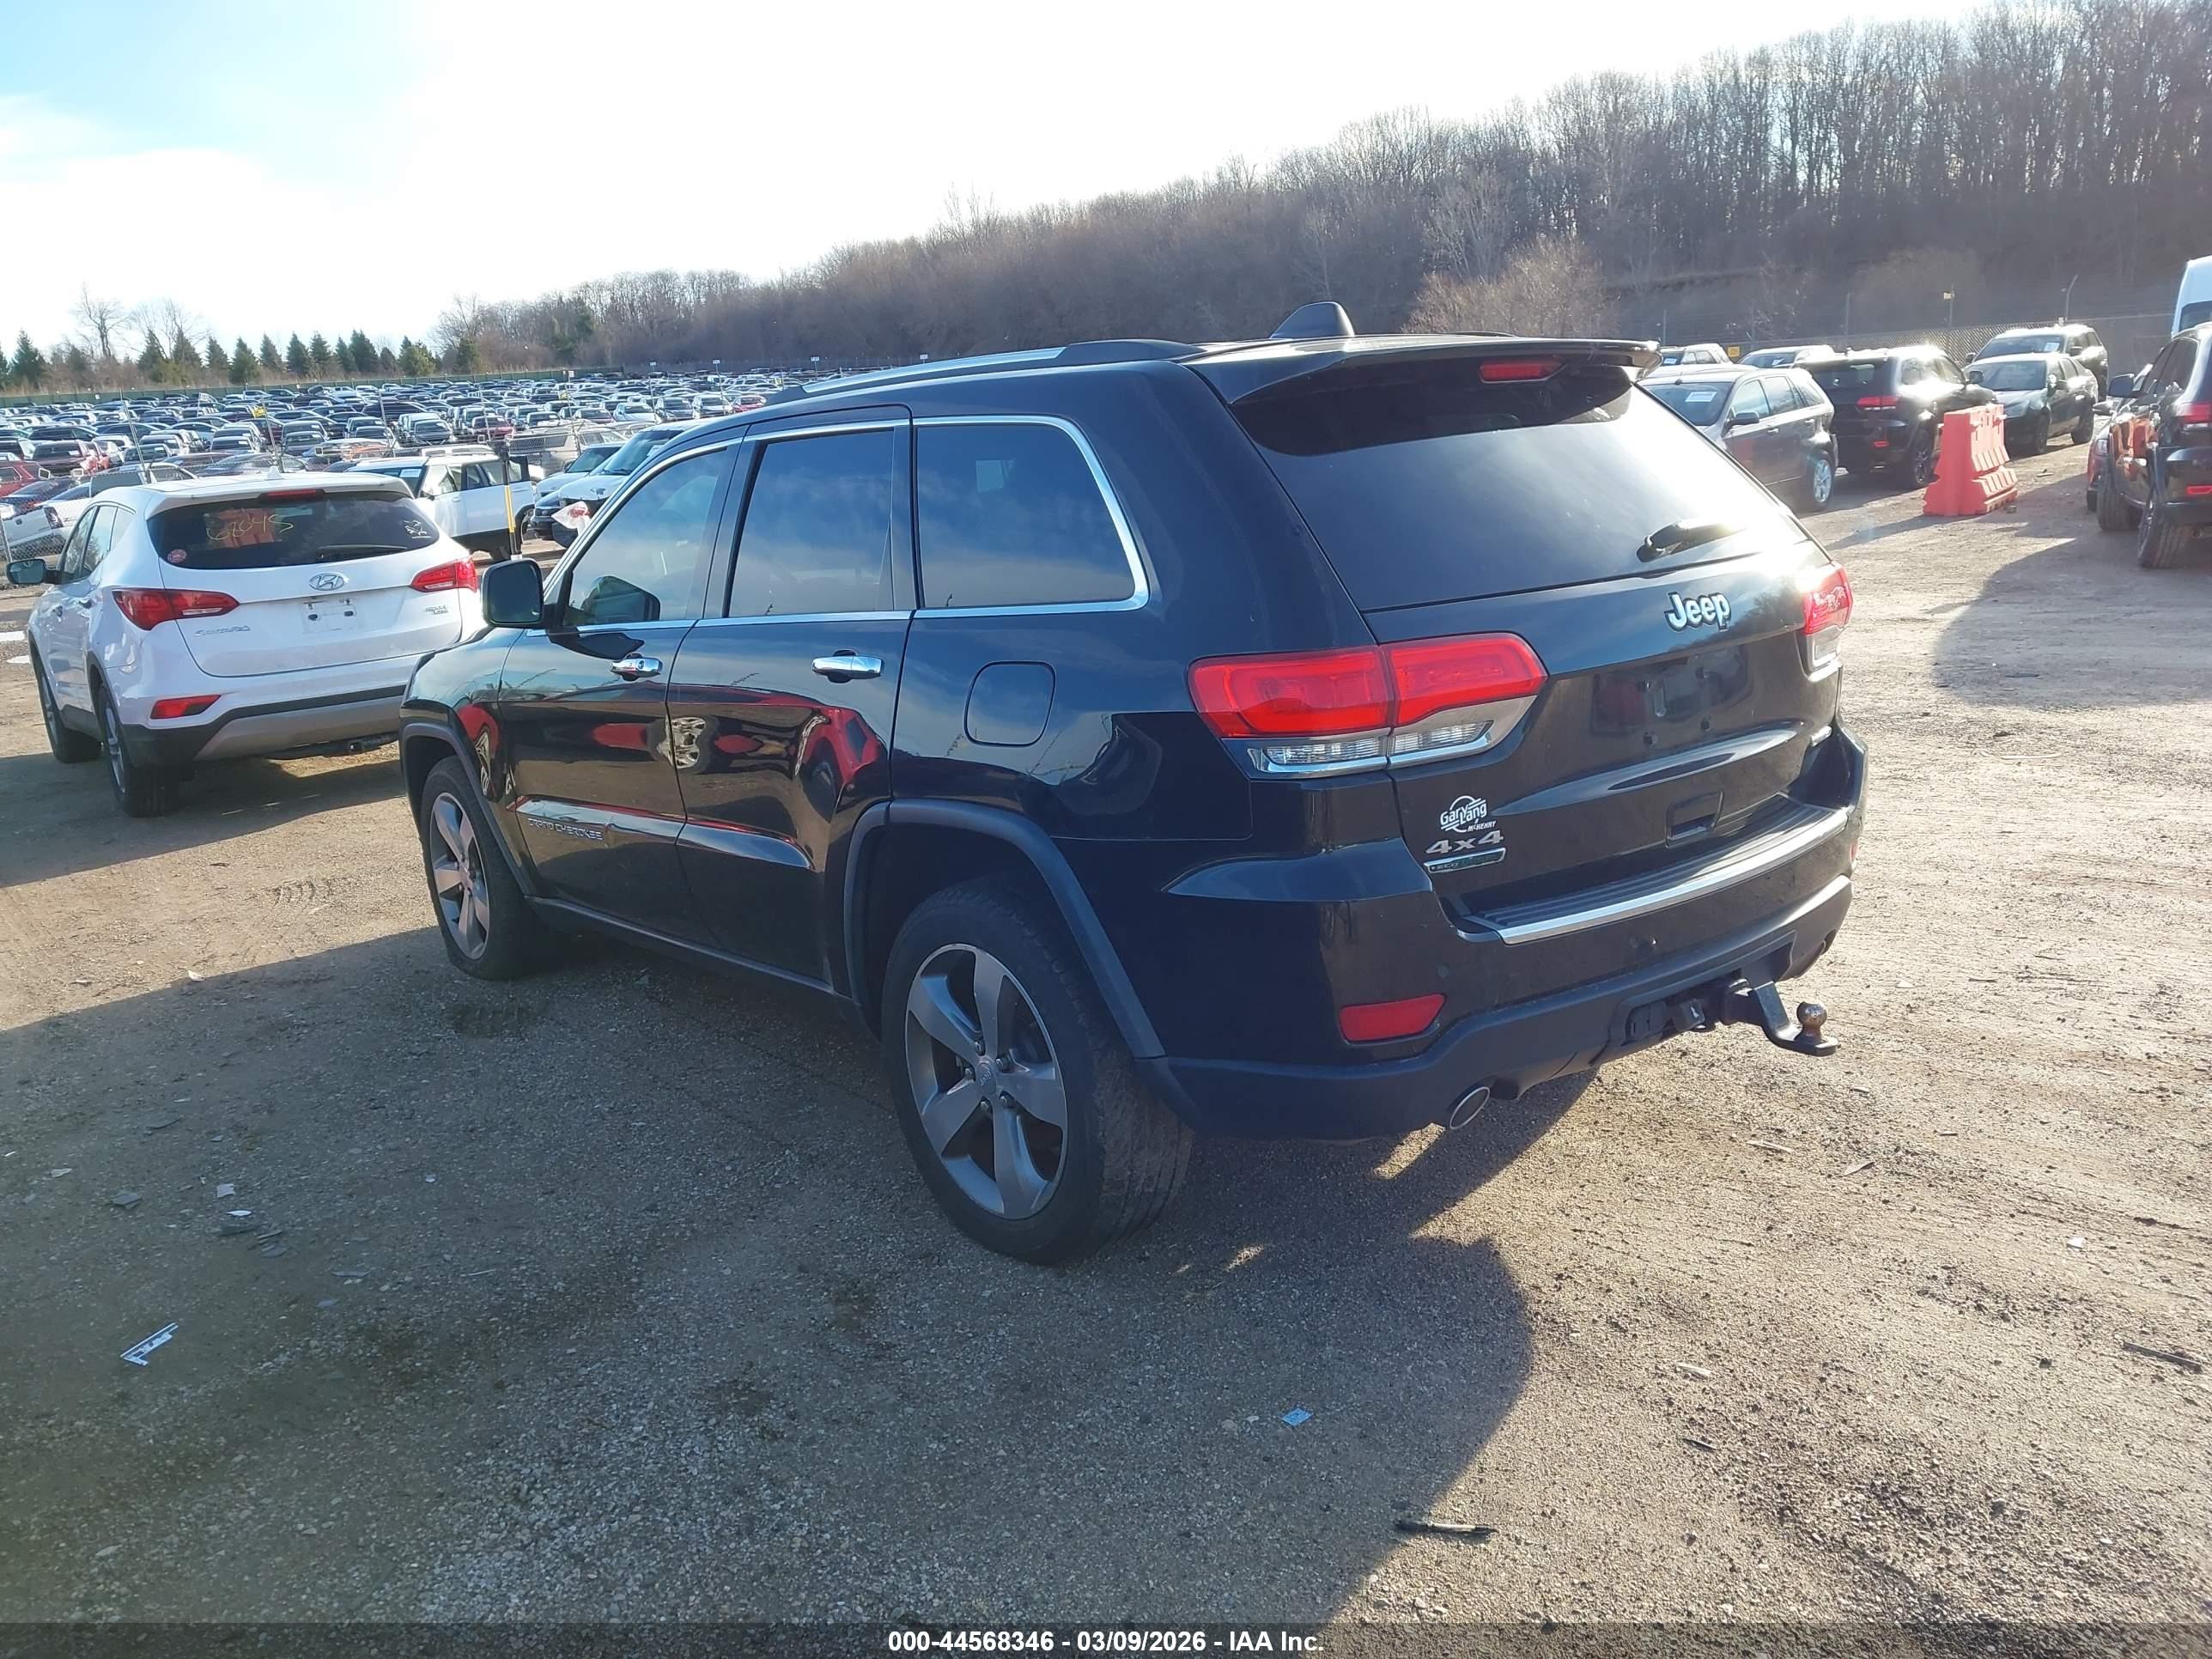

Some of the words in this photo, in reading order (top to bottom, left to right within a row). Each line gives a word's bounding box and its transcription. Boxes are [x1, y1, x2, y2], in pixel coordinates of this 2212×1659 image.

[1664, 591, 1732, 632] Jeep
[1440, 805, 1468, 826] Gary
[1460, 802, 1487, 825] Lang
